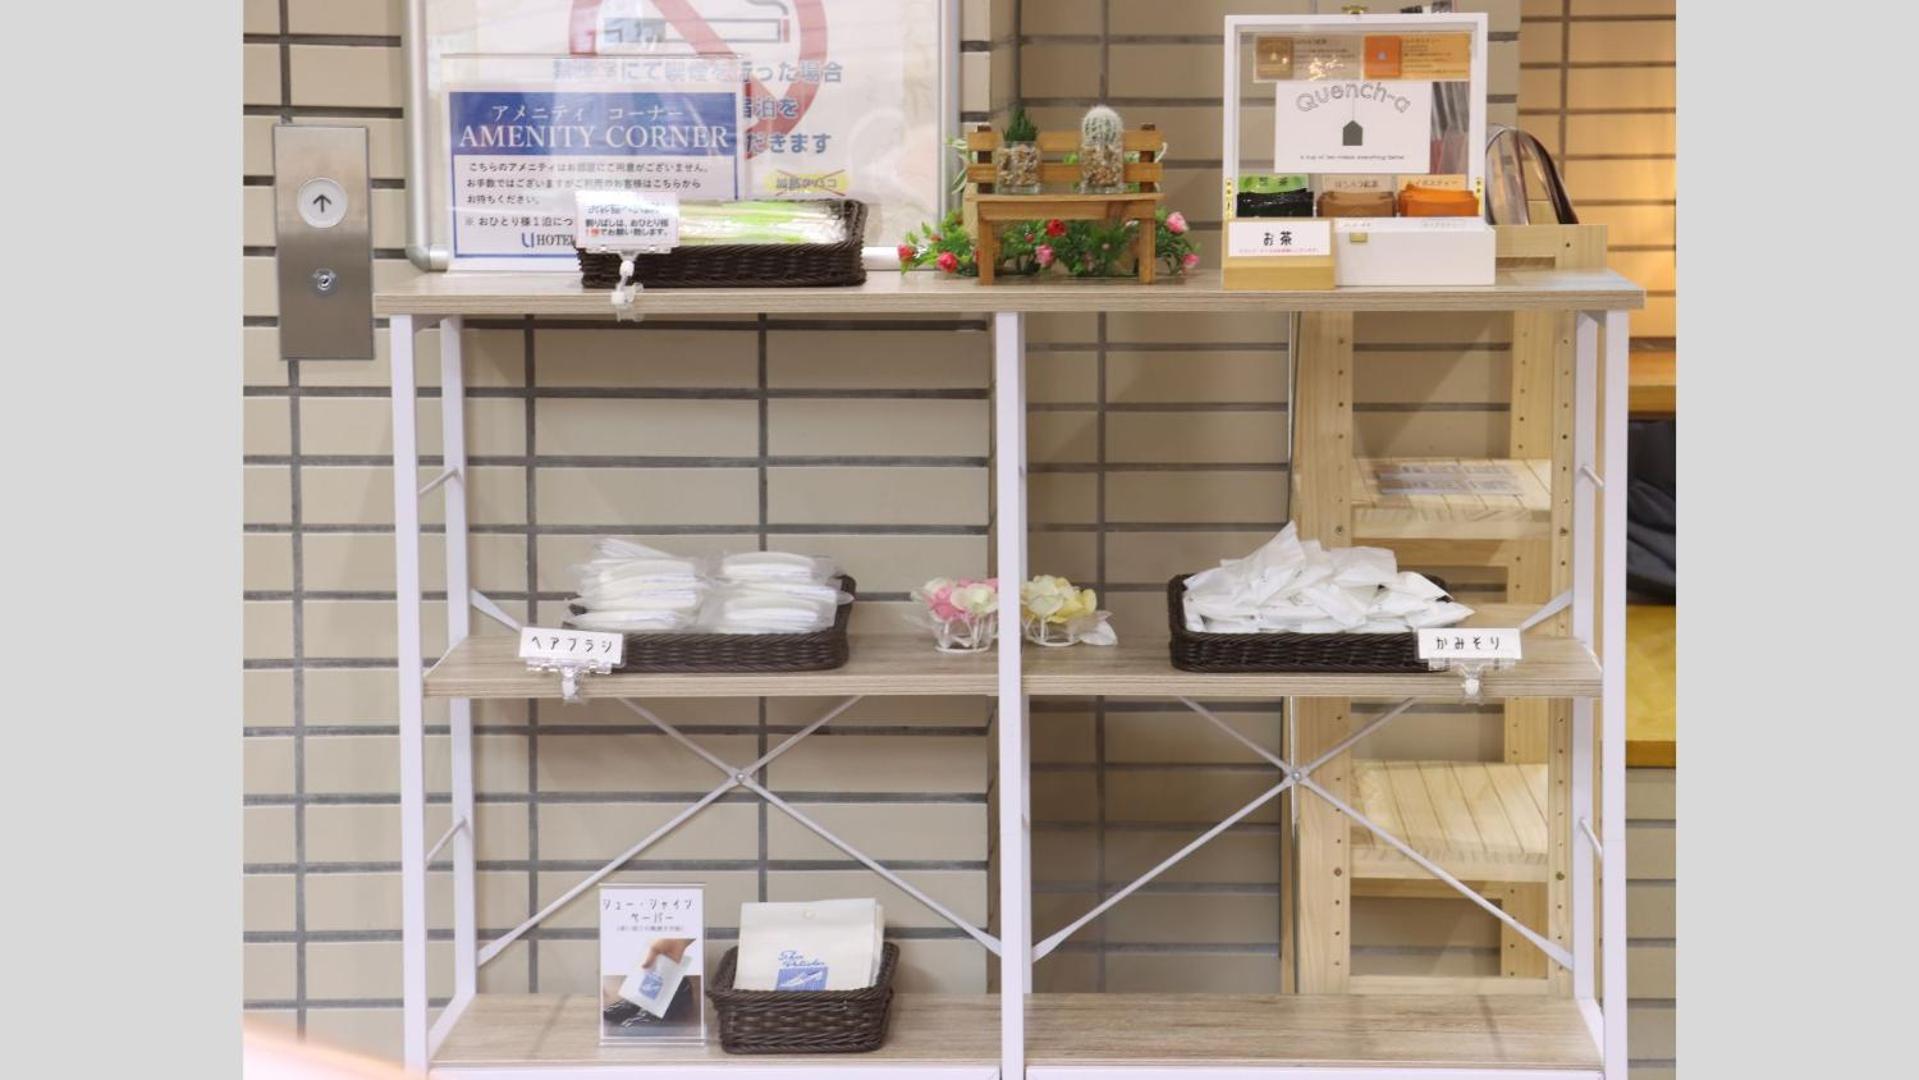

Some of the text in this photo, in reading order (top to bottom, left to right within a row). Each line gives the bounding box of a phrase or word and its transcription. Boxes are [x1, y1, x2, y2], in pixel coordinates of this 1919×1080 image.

[1295, 82, 1411, 113] Quench-a
[492, 105, 684, 121] アメニティ コーナー
[459, 125, 729, 148] AMENITY CORNER
[466, 194, 540, 206] お持ちください。
[1263, 230, 1292, 246] お茶
[1436, 636, 1500, 650] かみそり
